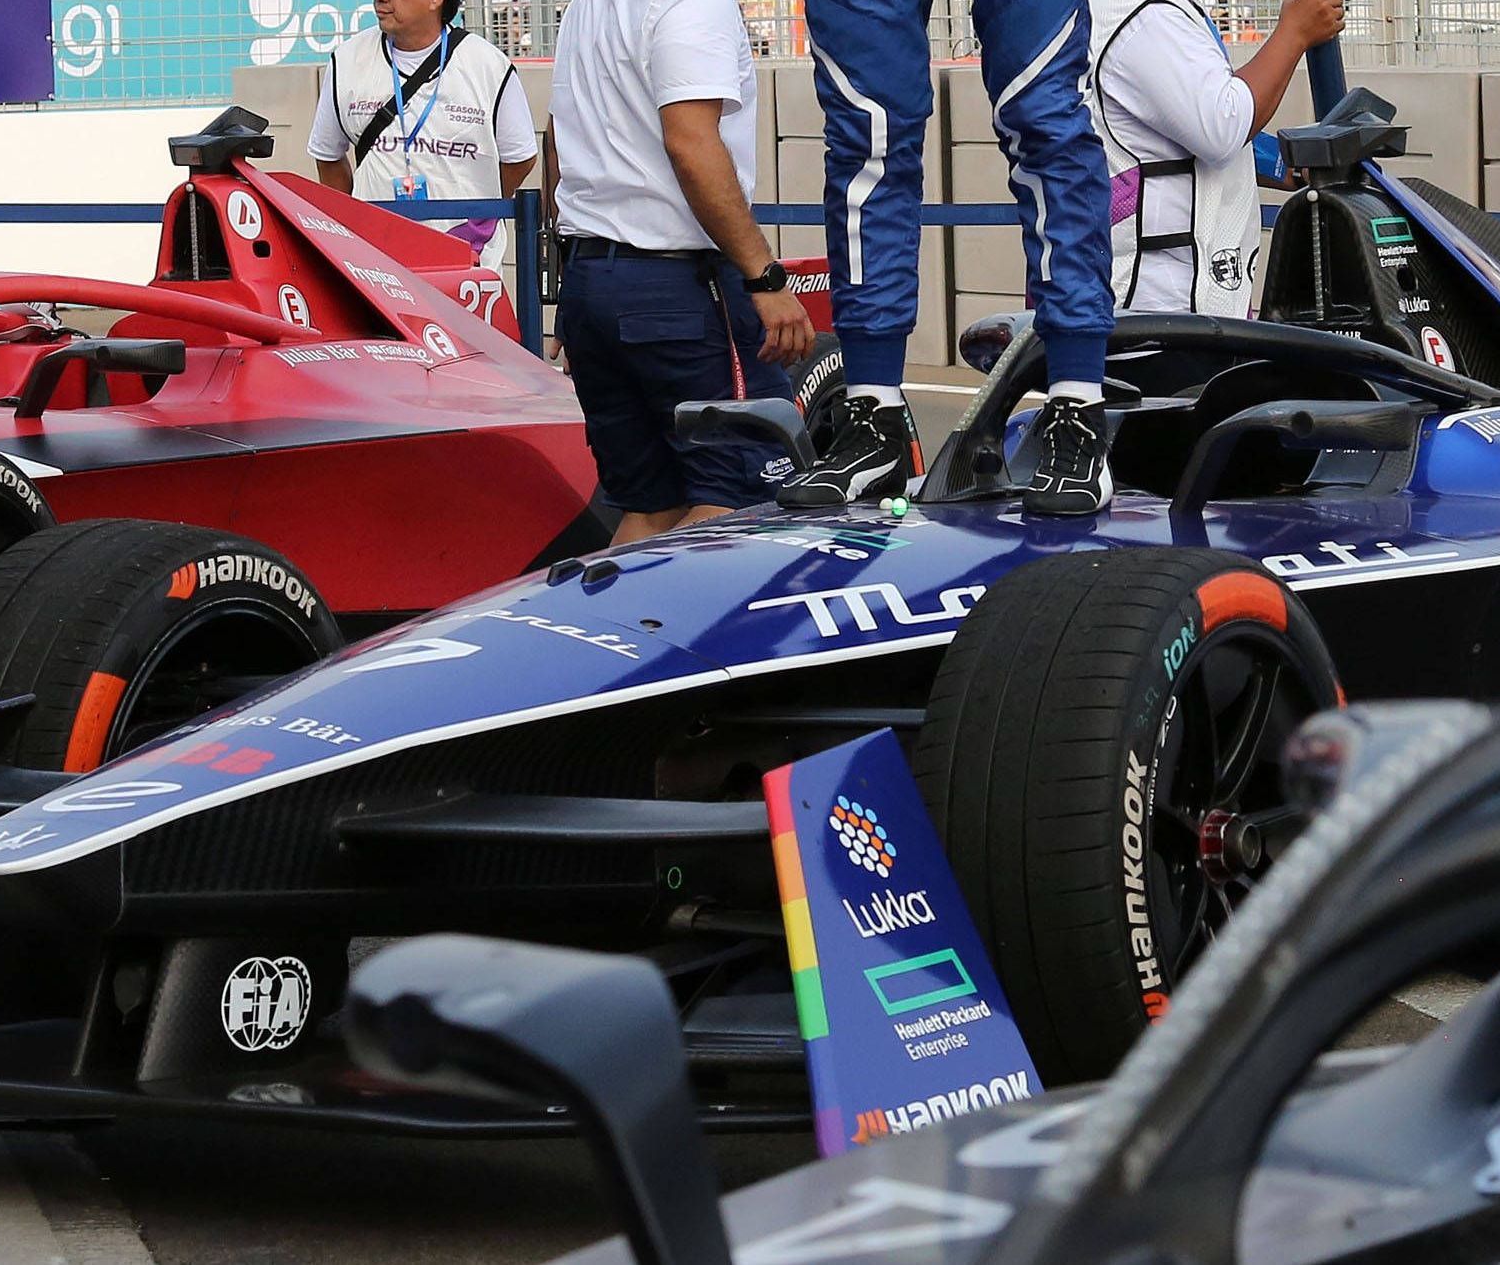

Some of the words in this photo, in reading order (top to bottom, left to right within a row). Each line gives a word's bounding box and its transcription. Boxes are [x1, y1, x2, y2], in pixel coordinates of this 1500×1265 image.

[342, 259, 405, 288] Prysmian
[458, 280, 503, 328] 27
[273, 345, 331, 368] Julius
[326, 343, 360, 360] Bär
[197, 554, 317, 619] Hankook
[277, 716, 362, 746] Bär
[1122, 749, 1162, 991] Hankook
[841, 887, 937, 938] Lukka
[893, 1010, 944, 1041] Hewlett
[942, 999, 993, 1028] Packard
[904, 1031, 969, 1062] Enterprise
